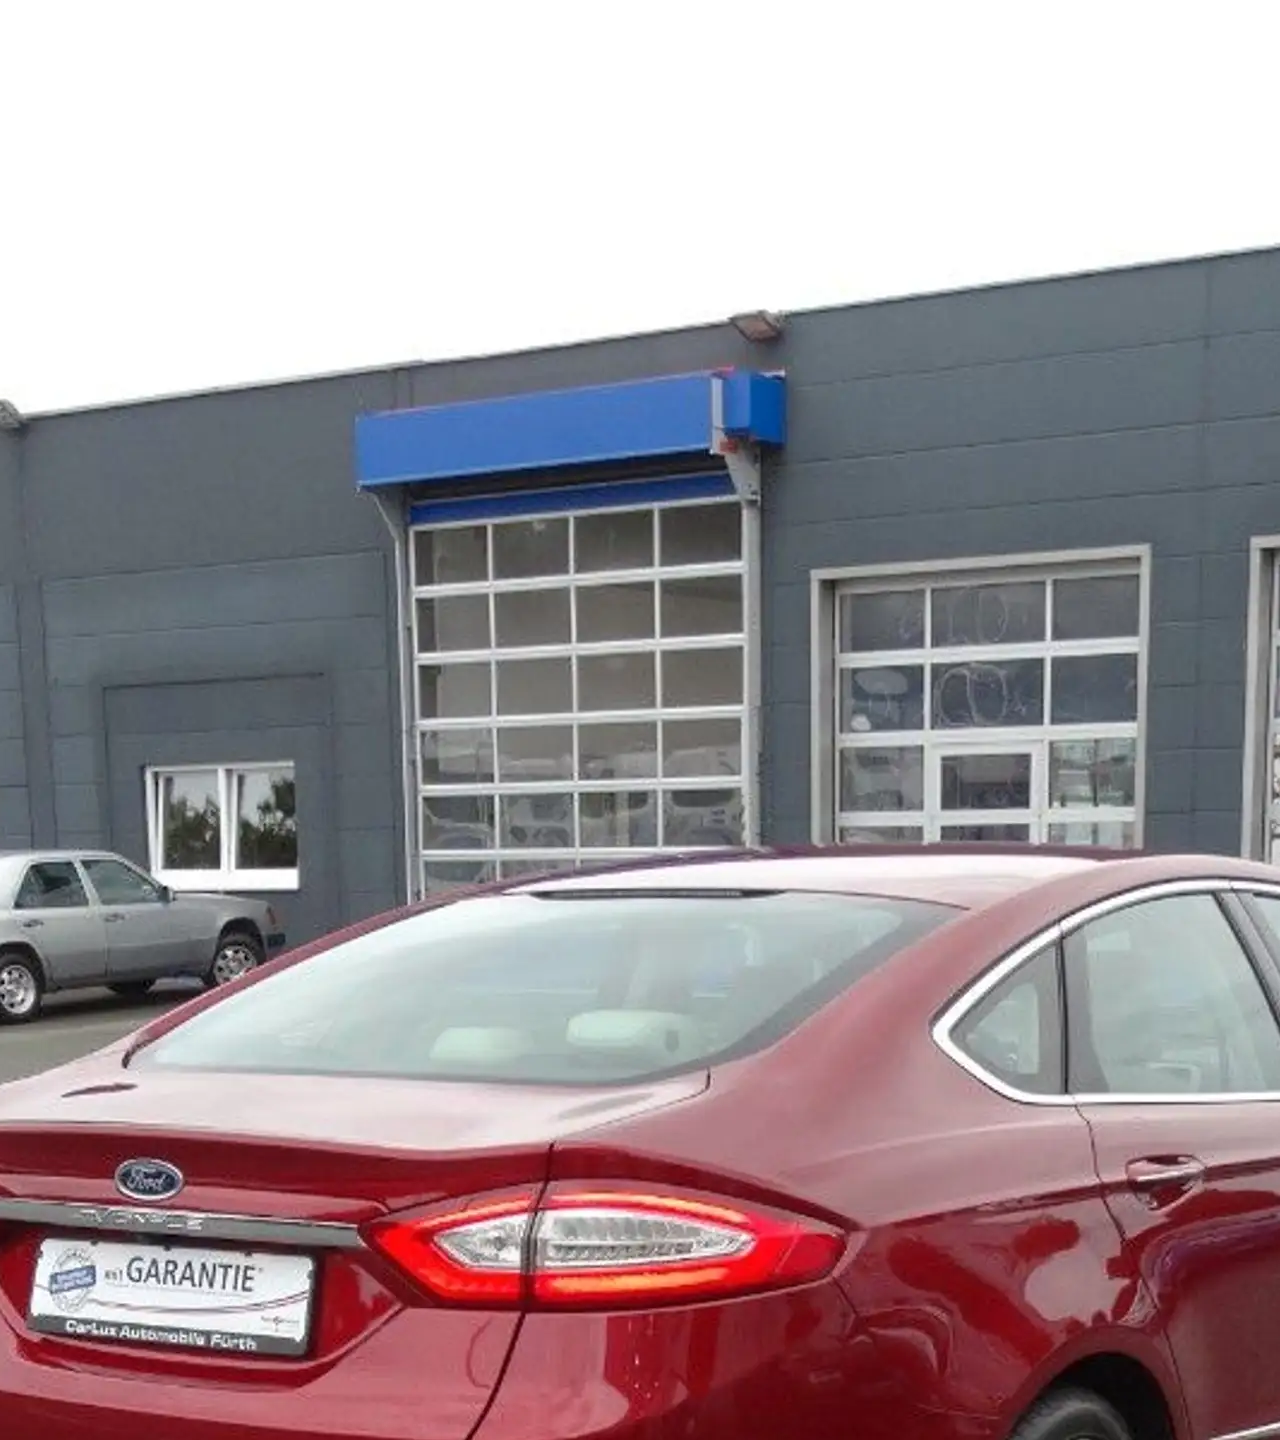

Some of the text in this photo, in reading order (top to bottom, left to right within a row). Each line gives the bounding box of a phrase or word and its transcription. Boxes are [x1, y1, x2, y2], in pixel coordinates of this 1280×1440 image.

[125, 1164, 167, 1192] Ford
[126, 1256, 256, 1292] GARANTIE
[65, 1318, 258, 1351] CarLux Automobile Fürth
